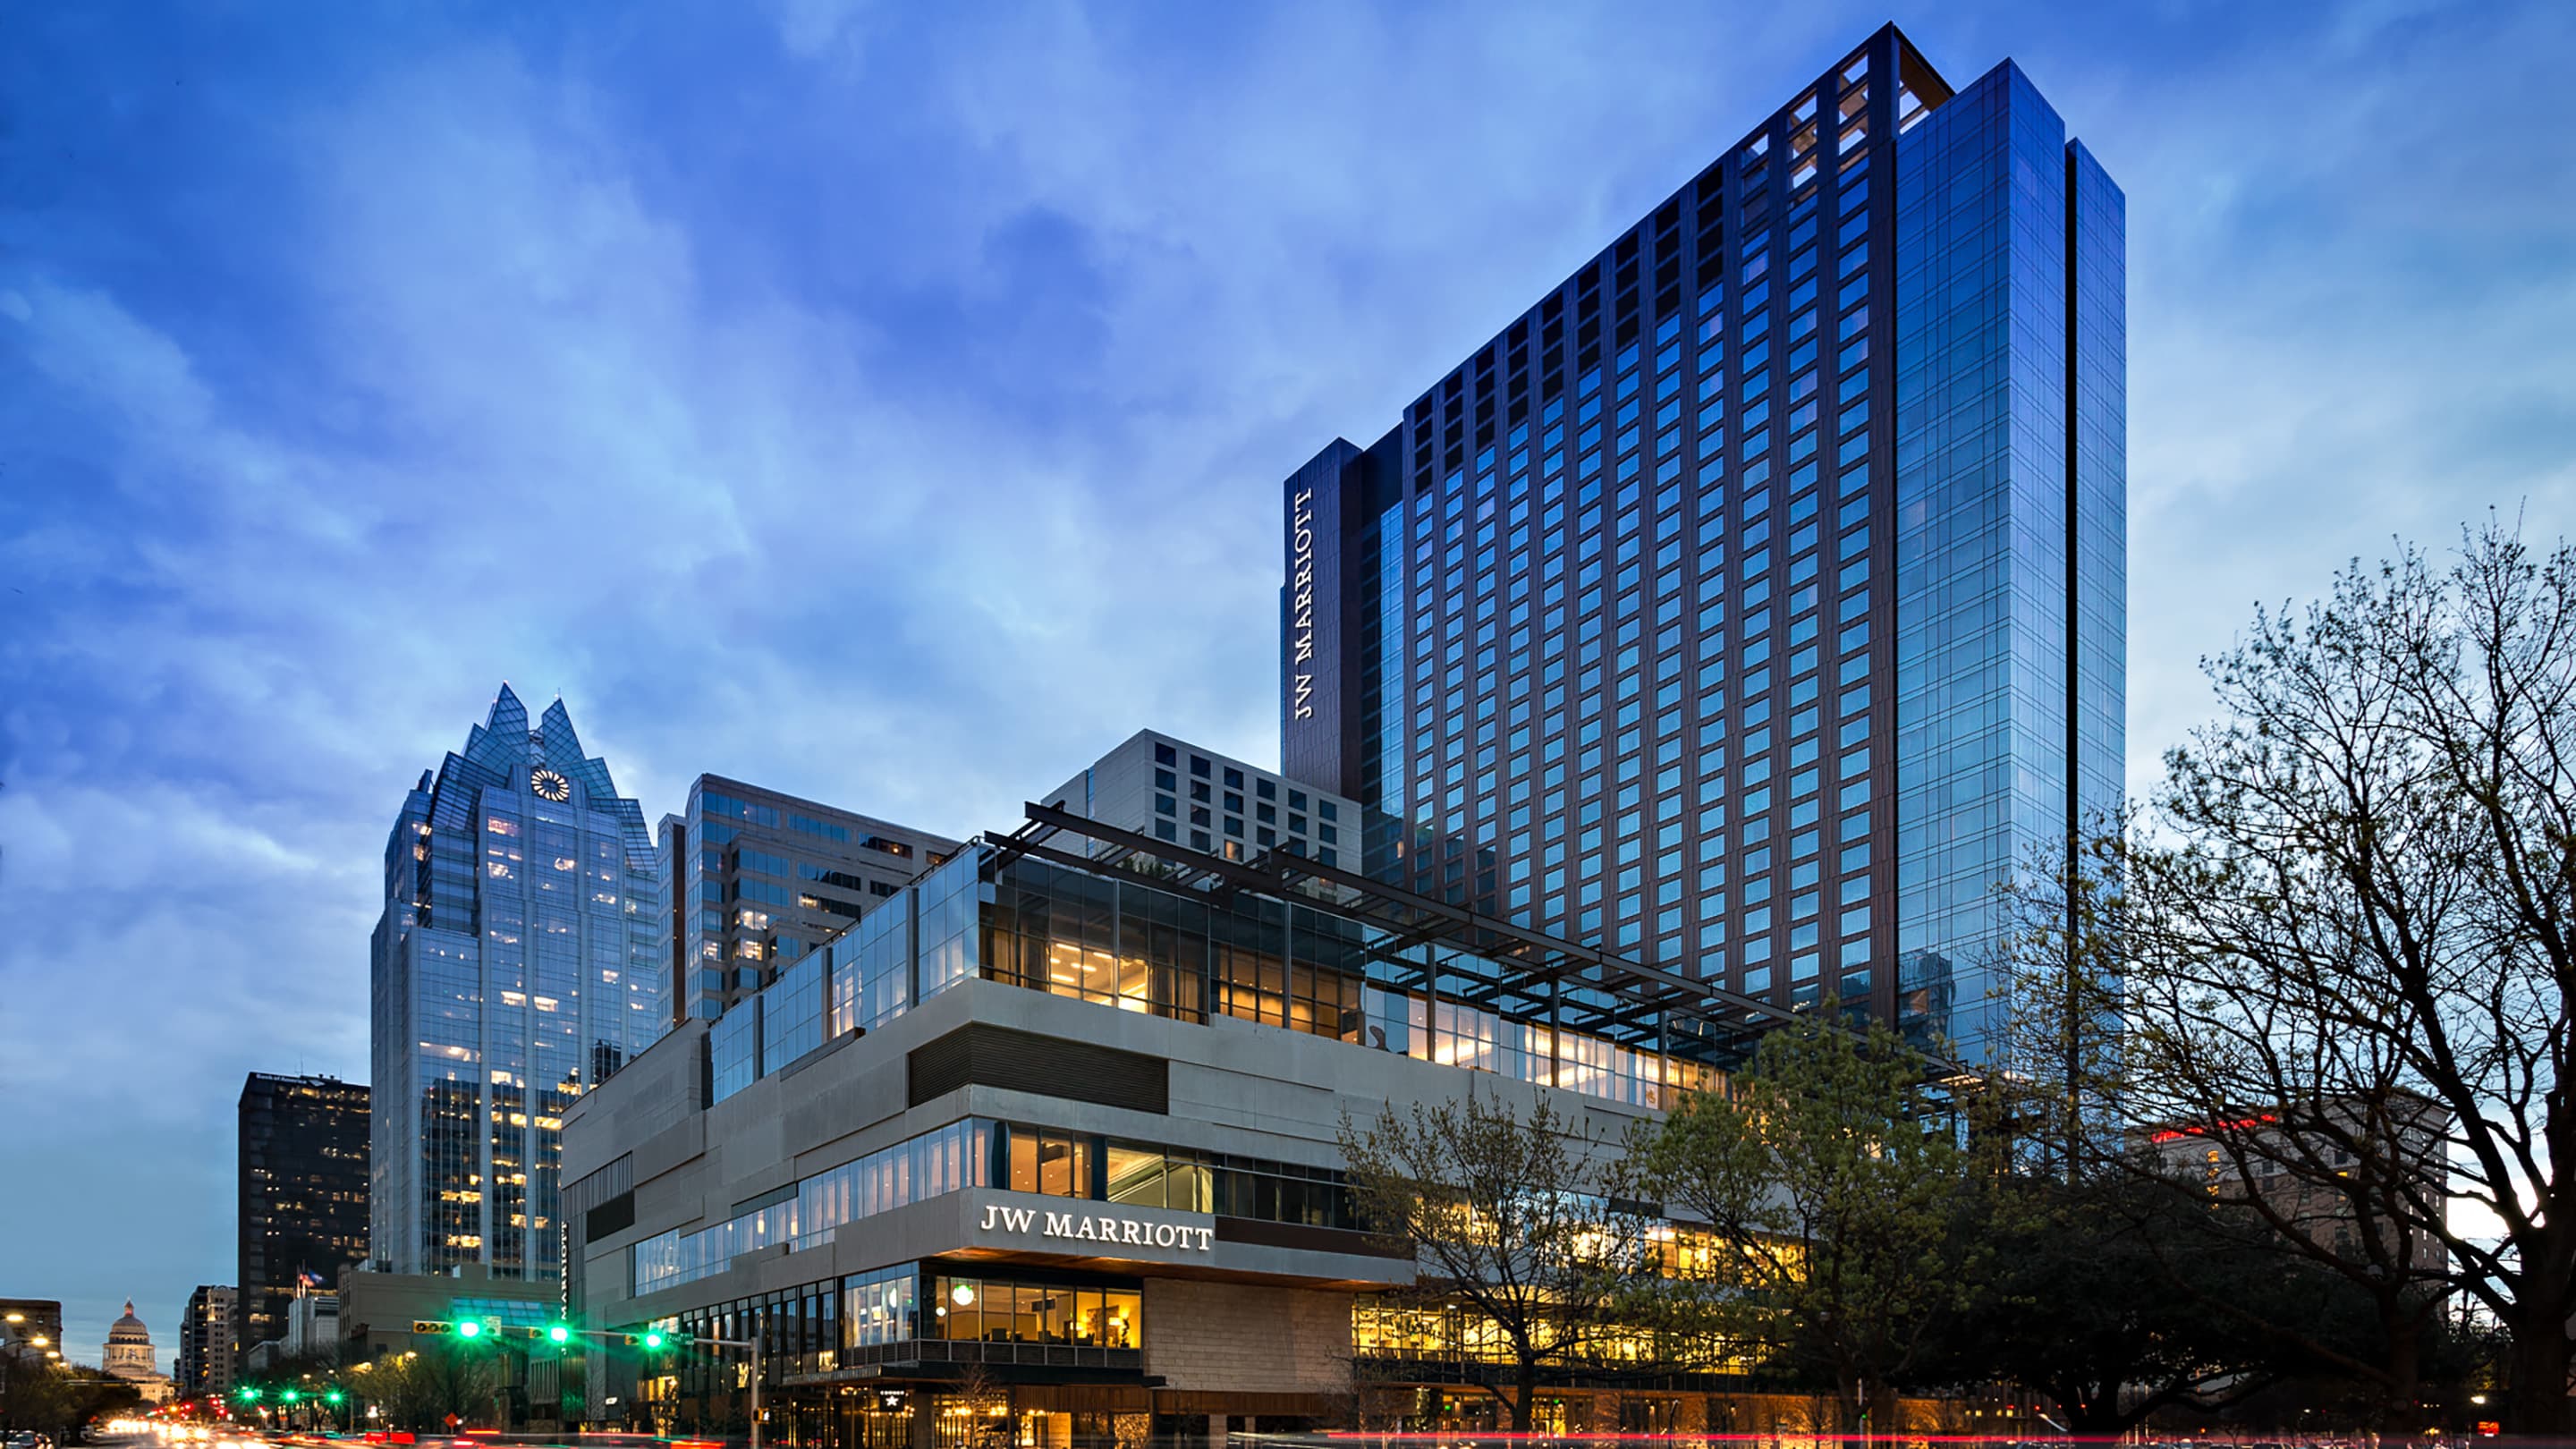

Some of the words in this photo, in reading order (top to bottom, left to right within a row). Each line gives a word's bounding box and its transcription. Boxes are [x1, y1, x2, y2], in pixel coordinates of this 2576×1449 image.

[1294, 487, 1312, 665] MARRIOTT
[1294, 674, 1312, 720] JW
[980, 1205, 1036, 1233] JW
[1043, 1211, 1213, 1250] MARRIOTT
